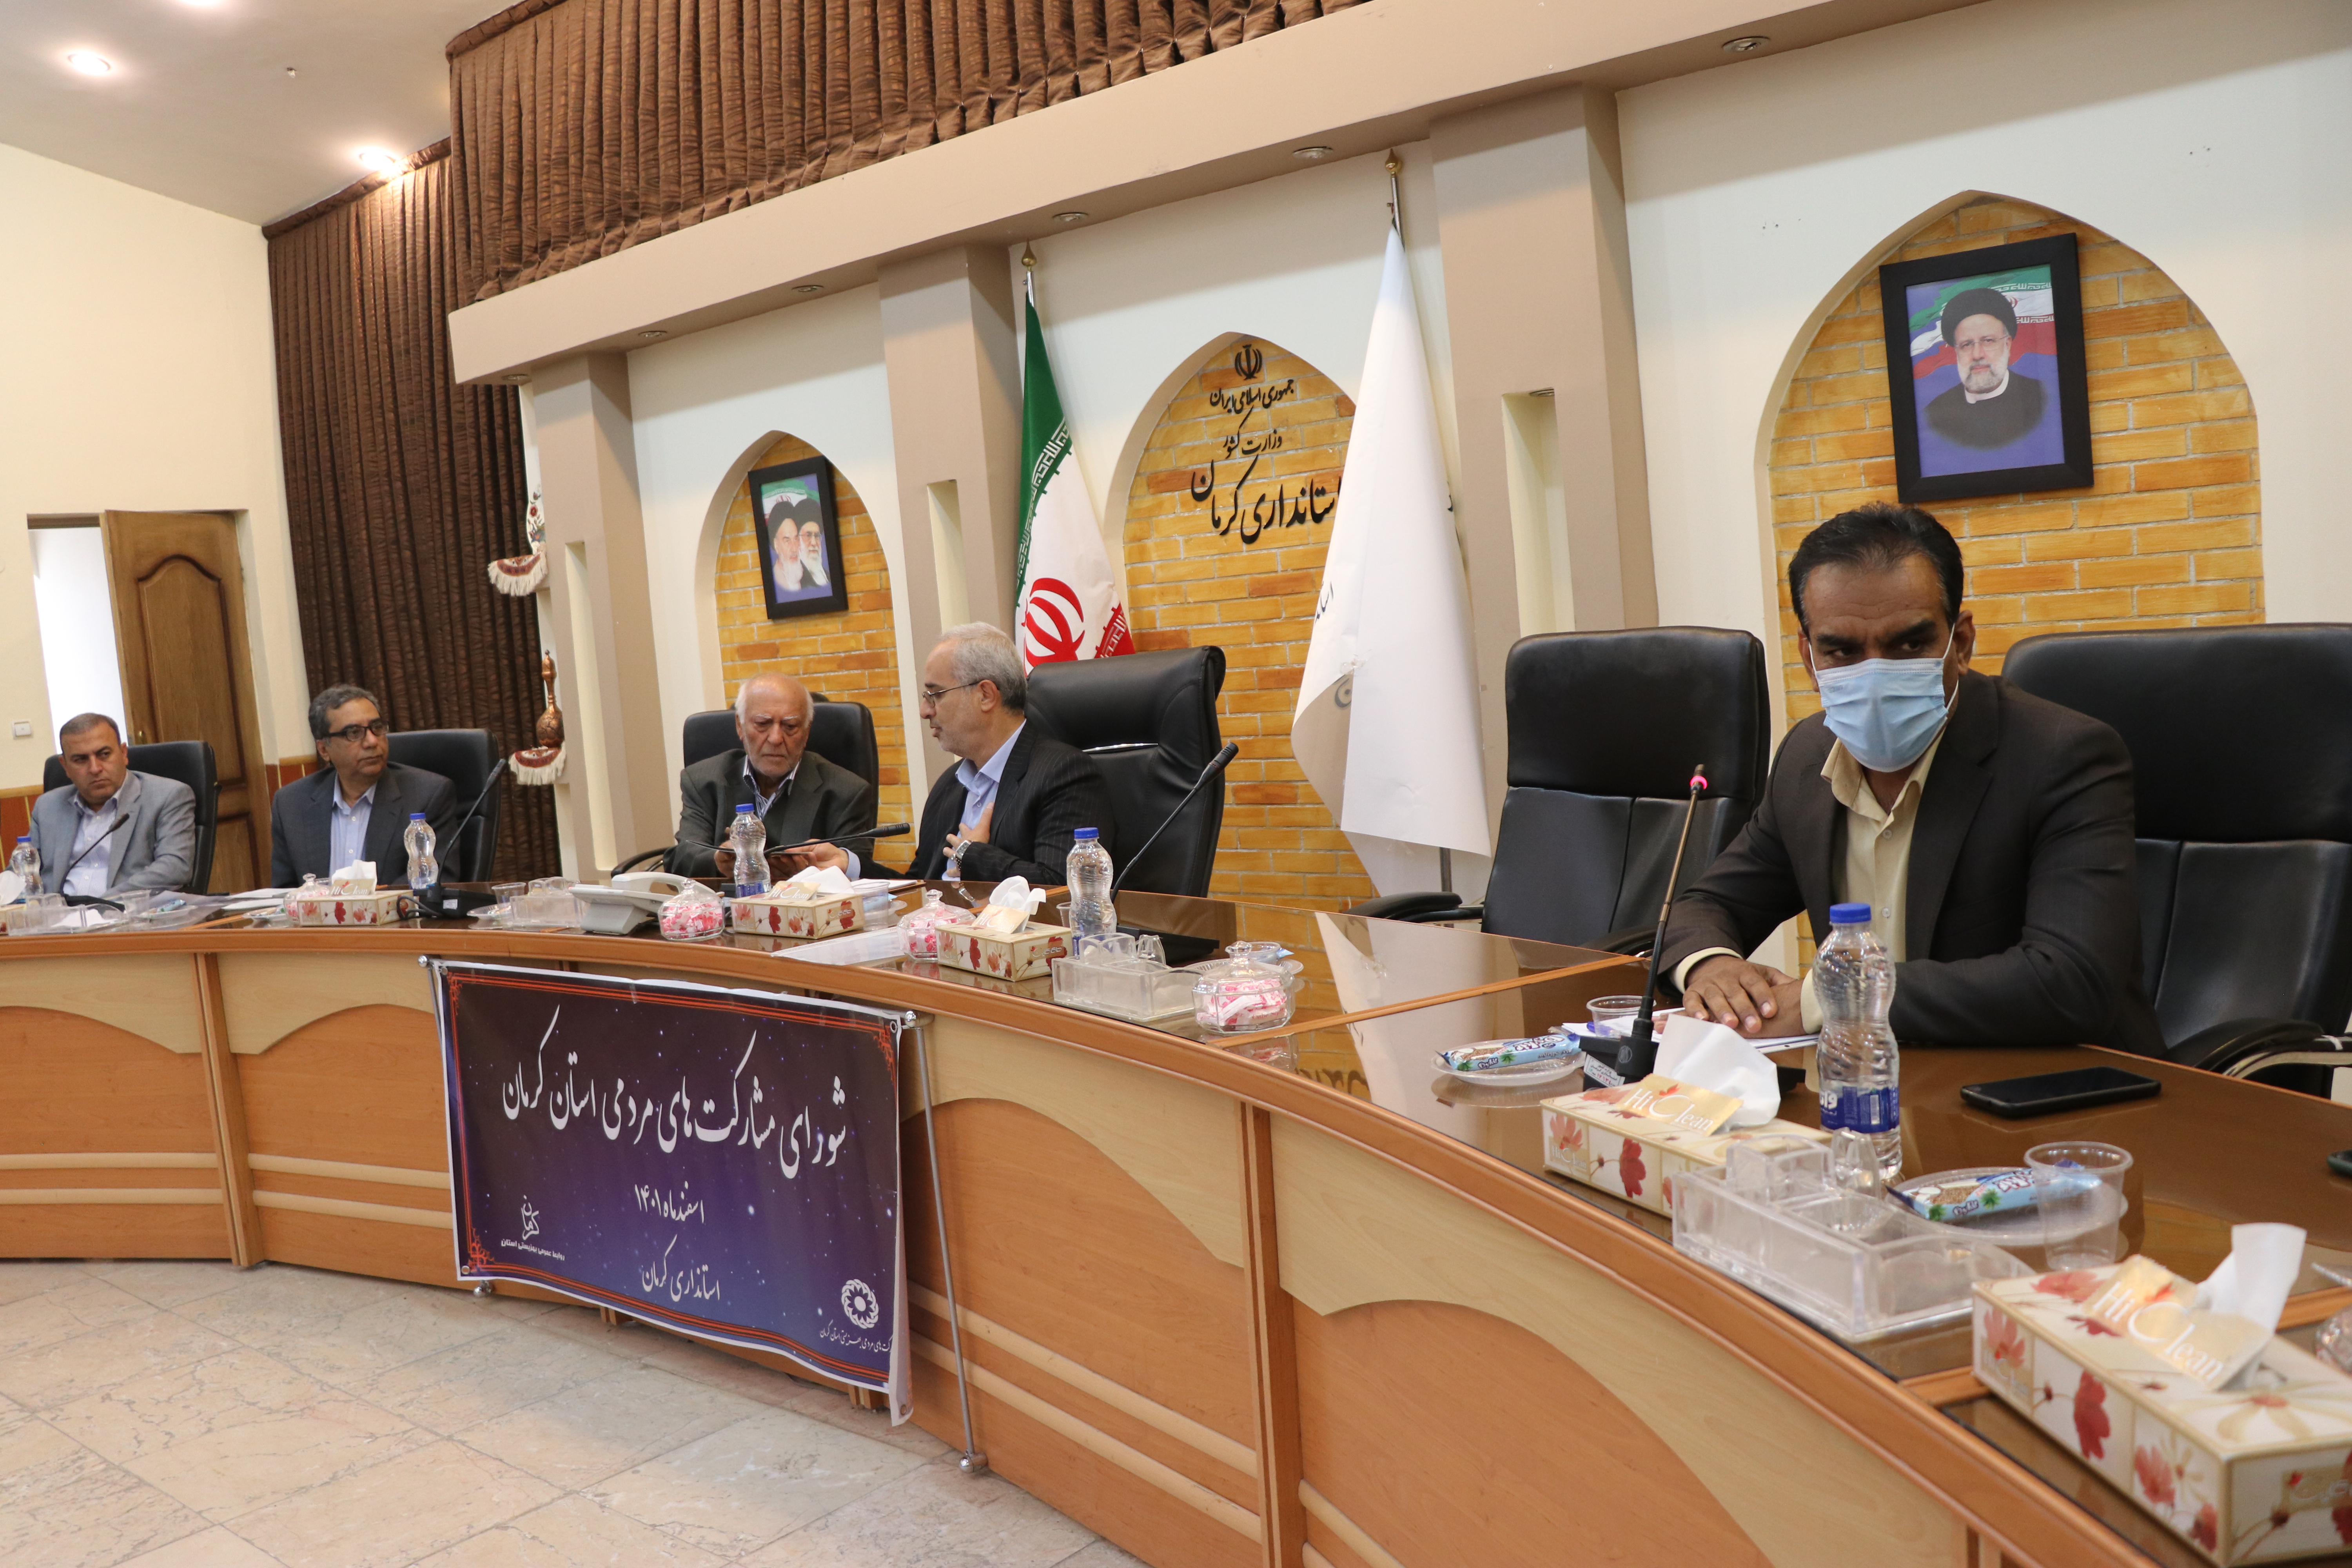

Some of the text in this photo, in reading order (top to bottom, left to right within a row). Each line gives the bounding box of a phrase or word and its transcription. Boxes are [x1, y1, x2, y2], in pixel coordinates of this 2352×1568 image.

[1210, 379, 1294, 414] جمهوری اسلامی ایران
[1223, 405, 1282, 459] وزارت کشور
[1191, 454, 1259, 536] کرمان
[503, 1005, 560, 1120] کرمان
[550, 1051, 596, 1130] استان
[602, 1078, 653, 1144] مردمی
[780, 1075, 846, 1179] شورای
[1623, 1088, 1714, 1132] Hi Clean
[634, 1183, 661, 1216] ۱۴۰۱
[501, 1238, 517, 1247] استان
[642, 1234, 720, 1302] استانداری کرمان
[2092, 1281, 2225, 1383] Hi Clean
